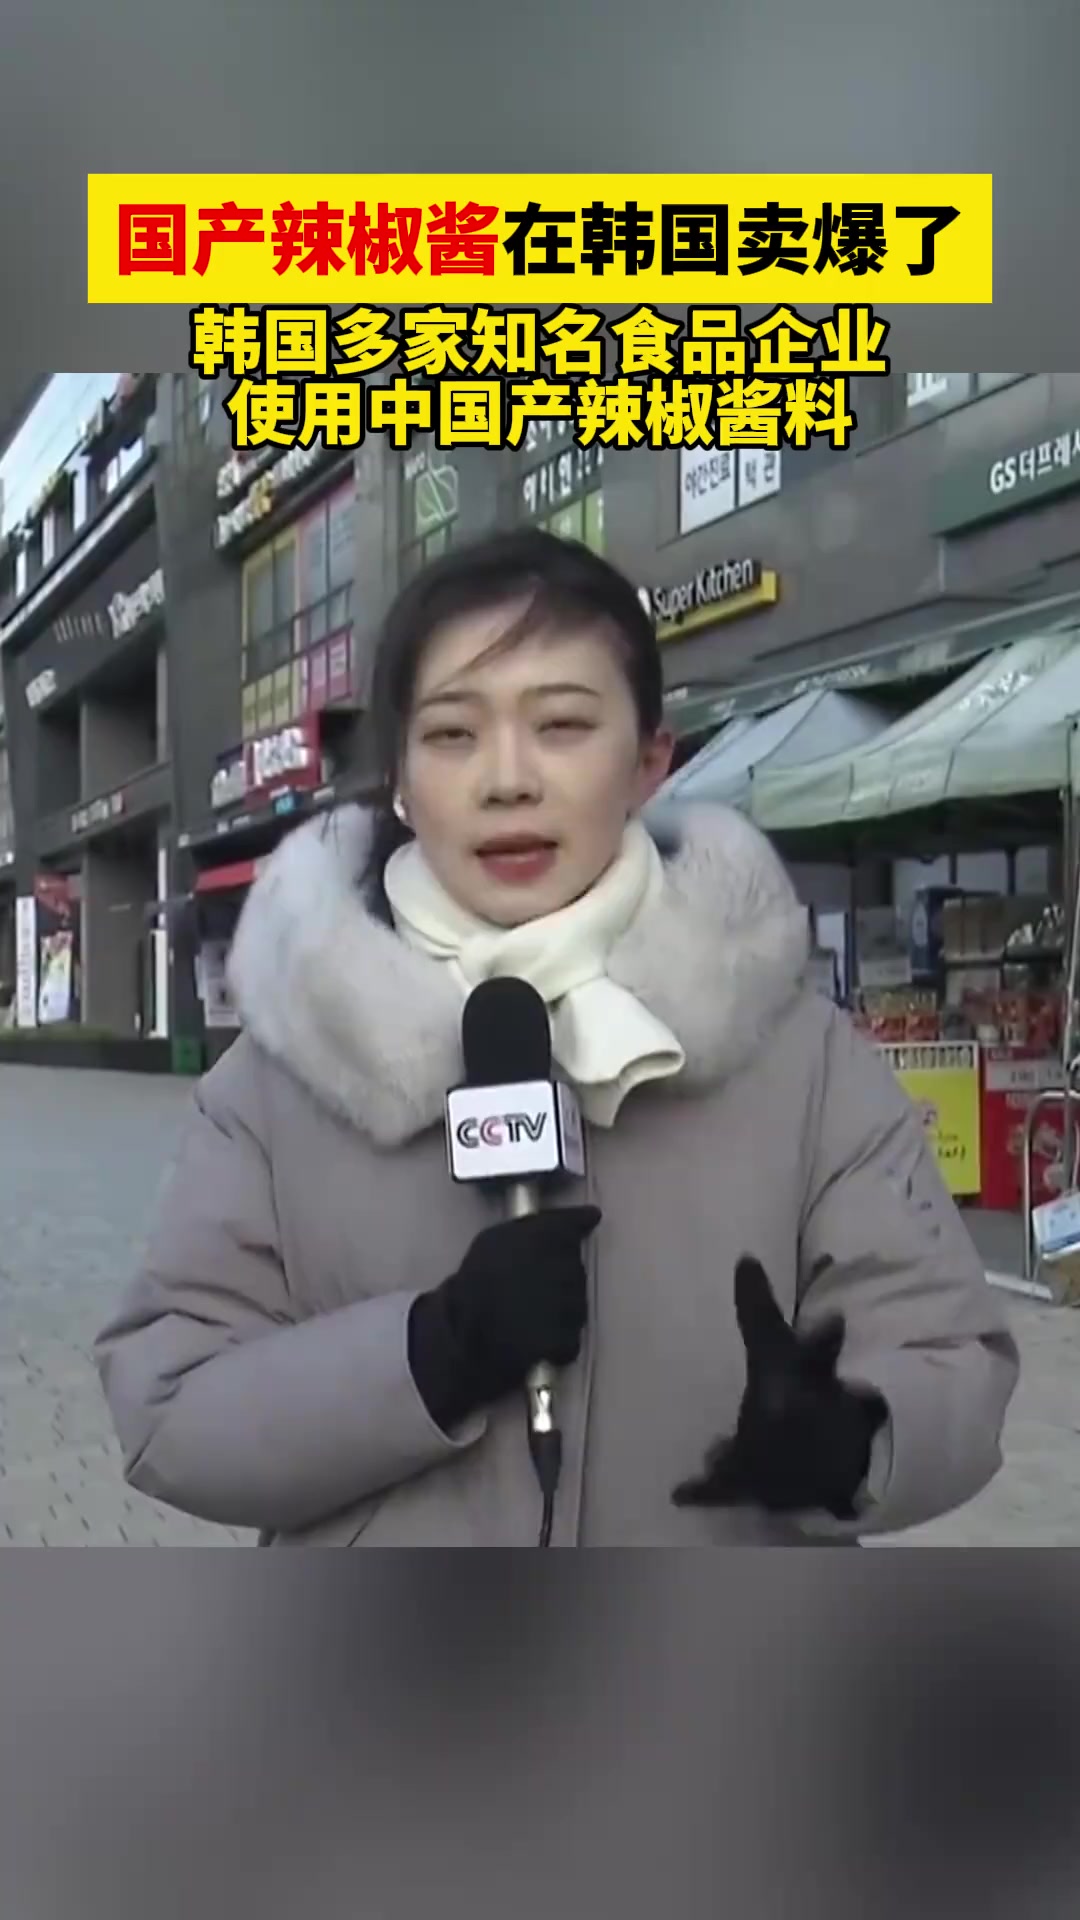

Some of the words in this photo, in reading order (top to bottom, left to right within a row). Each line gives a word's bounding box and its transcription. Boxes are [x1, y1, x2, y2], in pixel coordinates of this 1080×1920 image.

[653, 581, 696, 621] Super
[695, 558, 753, 609] Kitchen
[457, 1112, 547, 1149] CCTV
